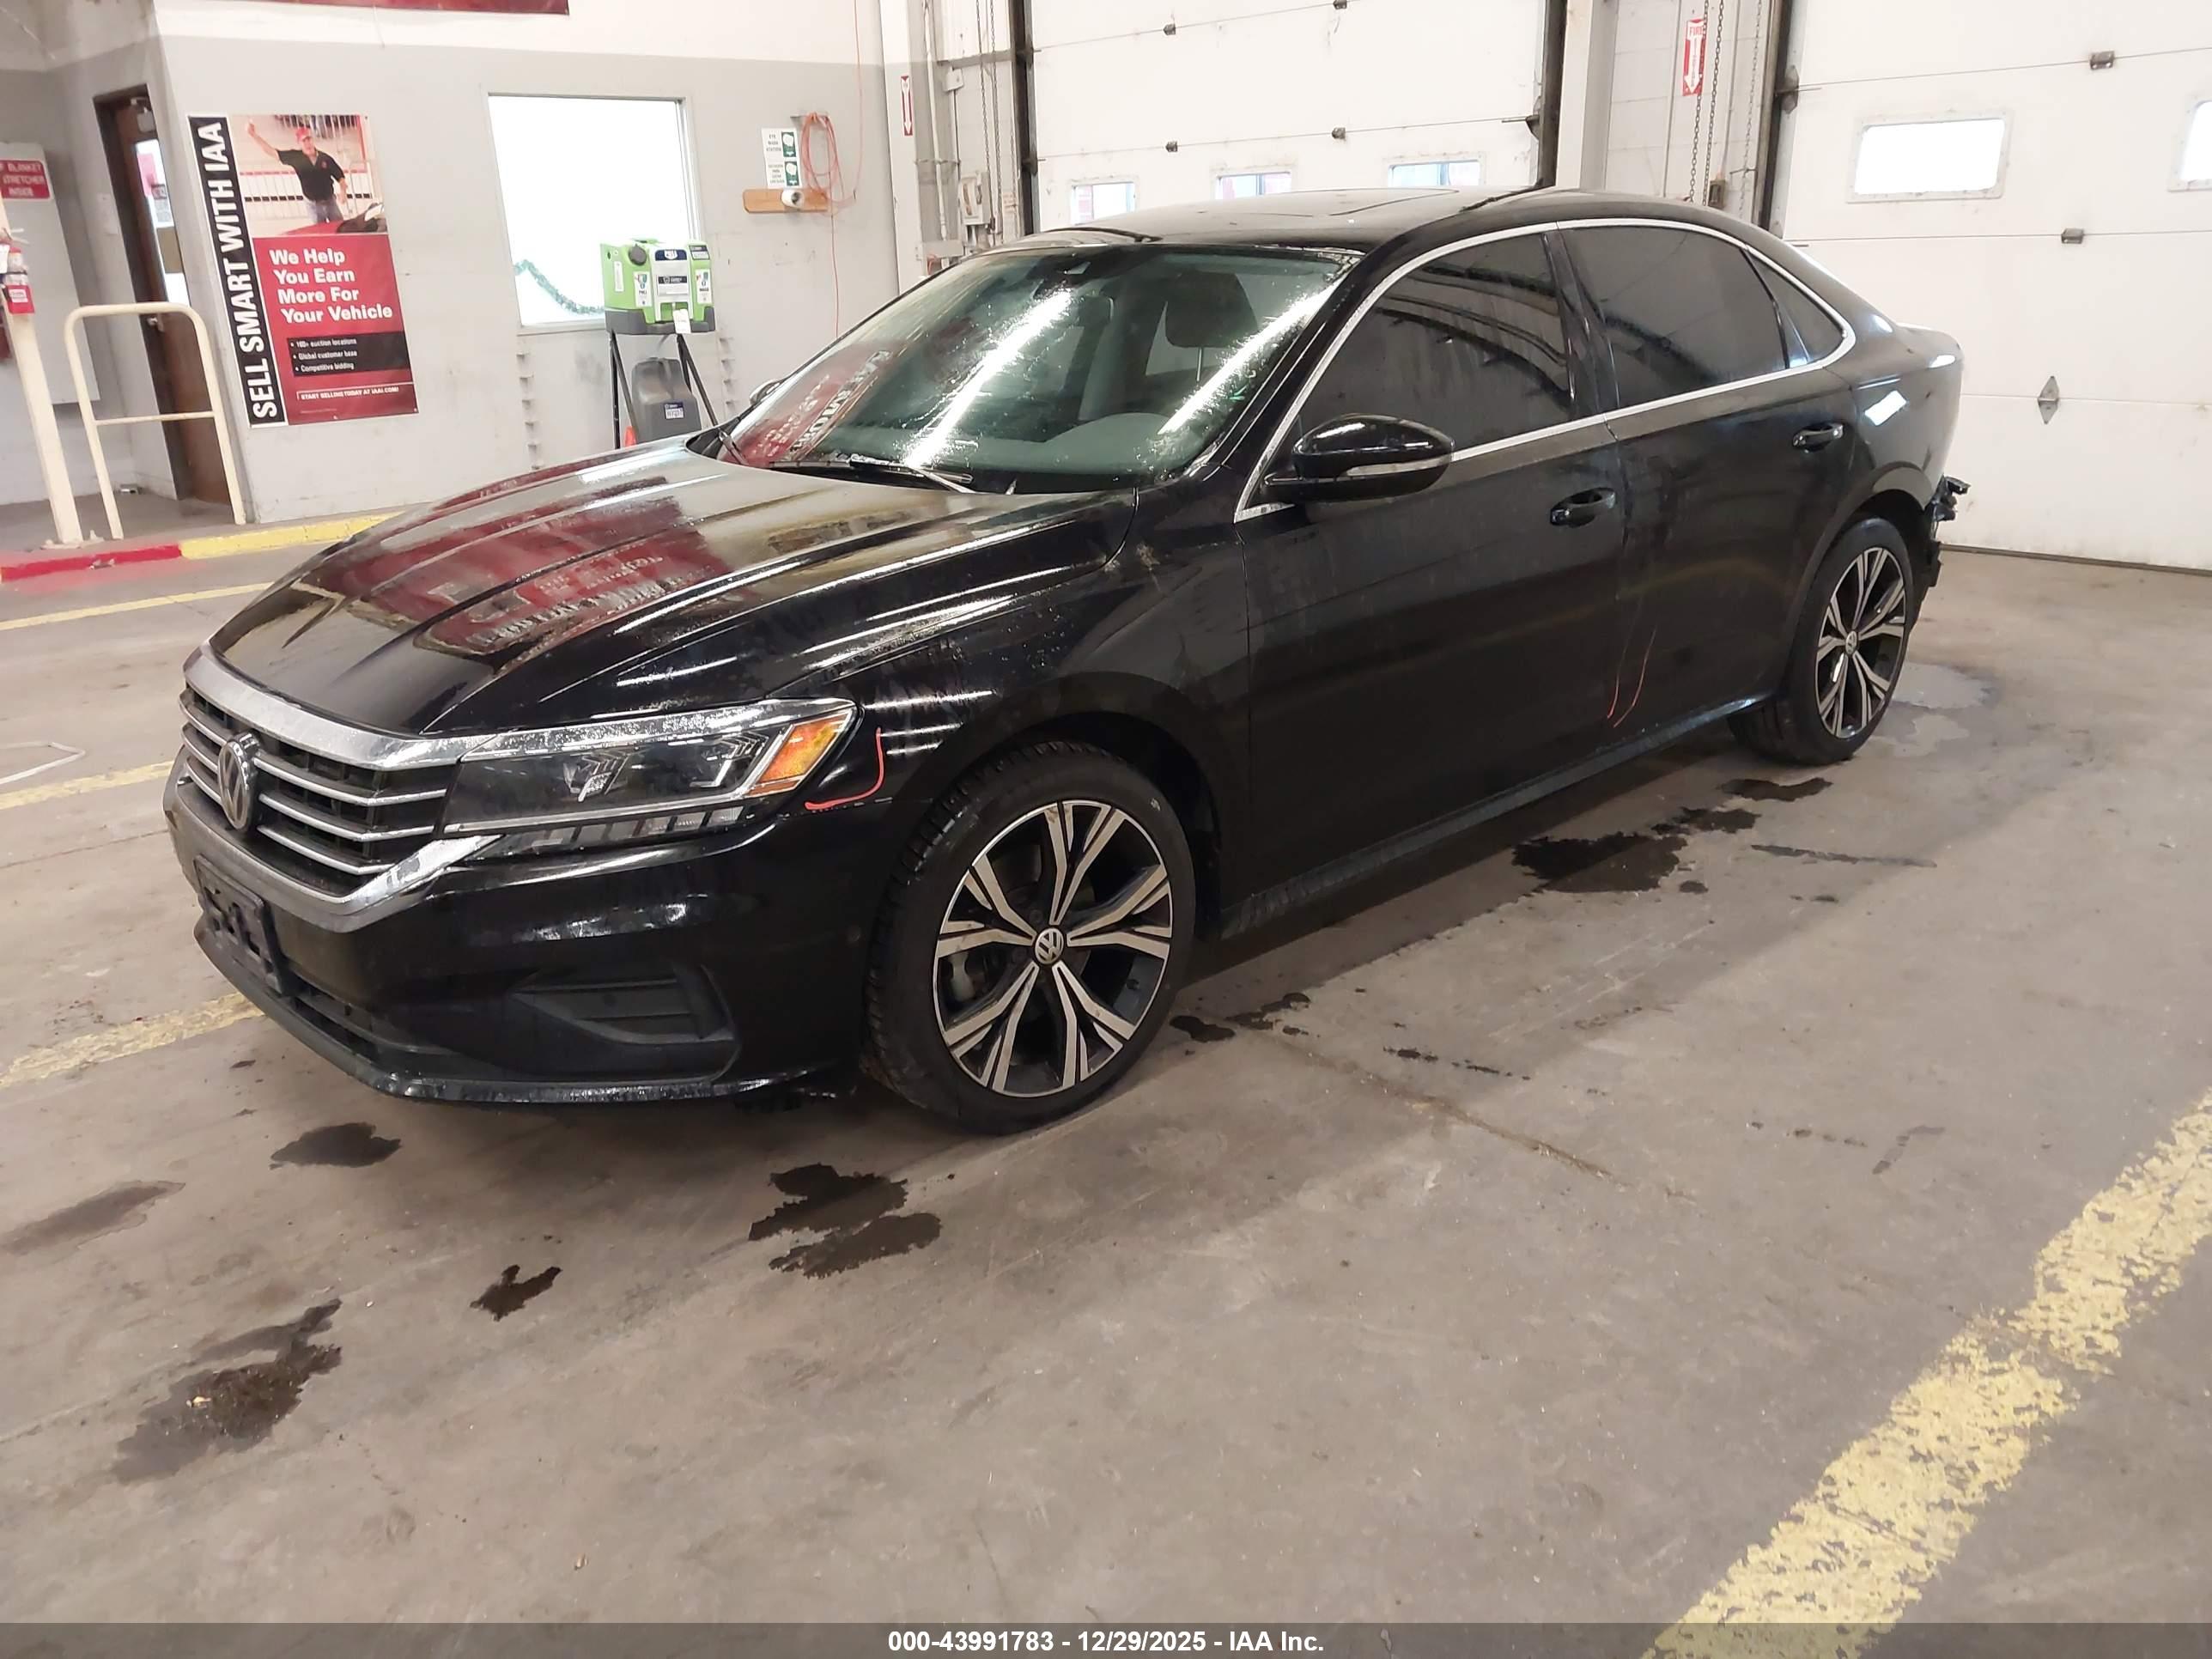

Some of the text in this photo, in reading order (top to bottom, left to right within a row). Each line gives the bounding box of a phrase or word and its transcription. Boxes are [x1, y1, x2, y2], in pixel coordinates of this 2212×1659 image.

[269, 247, 346, 266] We Help
[198, 122, 277, 419] SELL SMART WITH IAA
[273, 268, 356, 285] You Earn
[277, 286, 359, 304] More For
[281, 303, 393, 324] Your Vehicle
[301, 364, 333, 373] Competitive
[1035, 927, 1064, 964] VW
